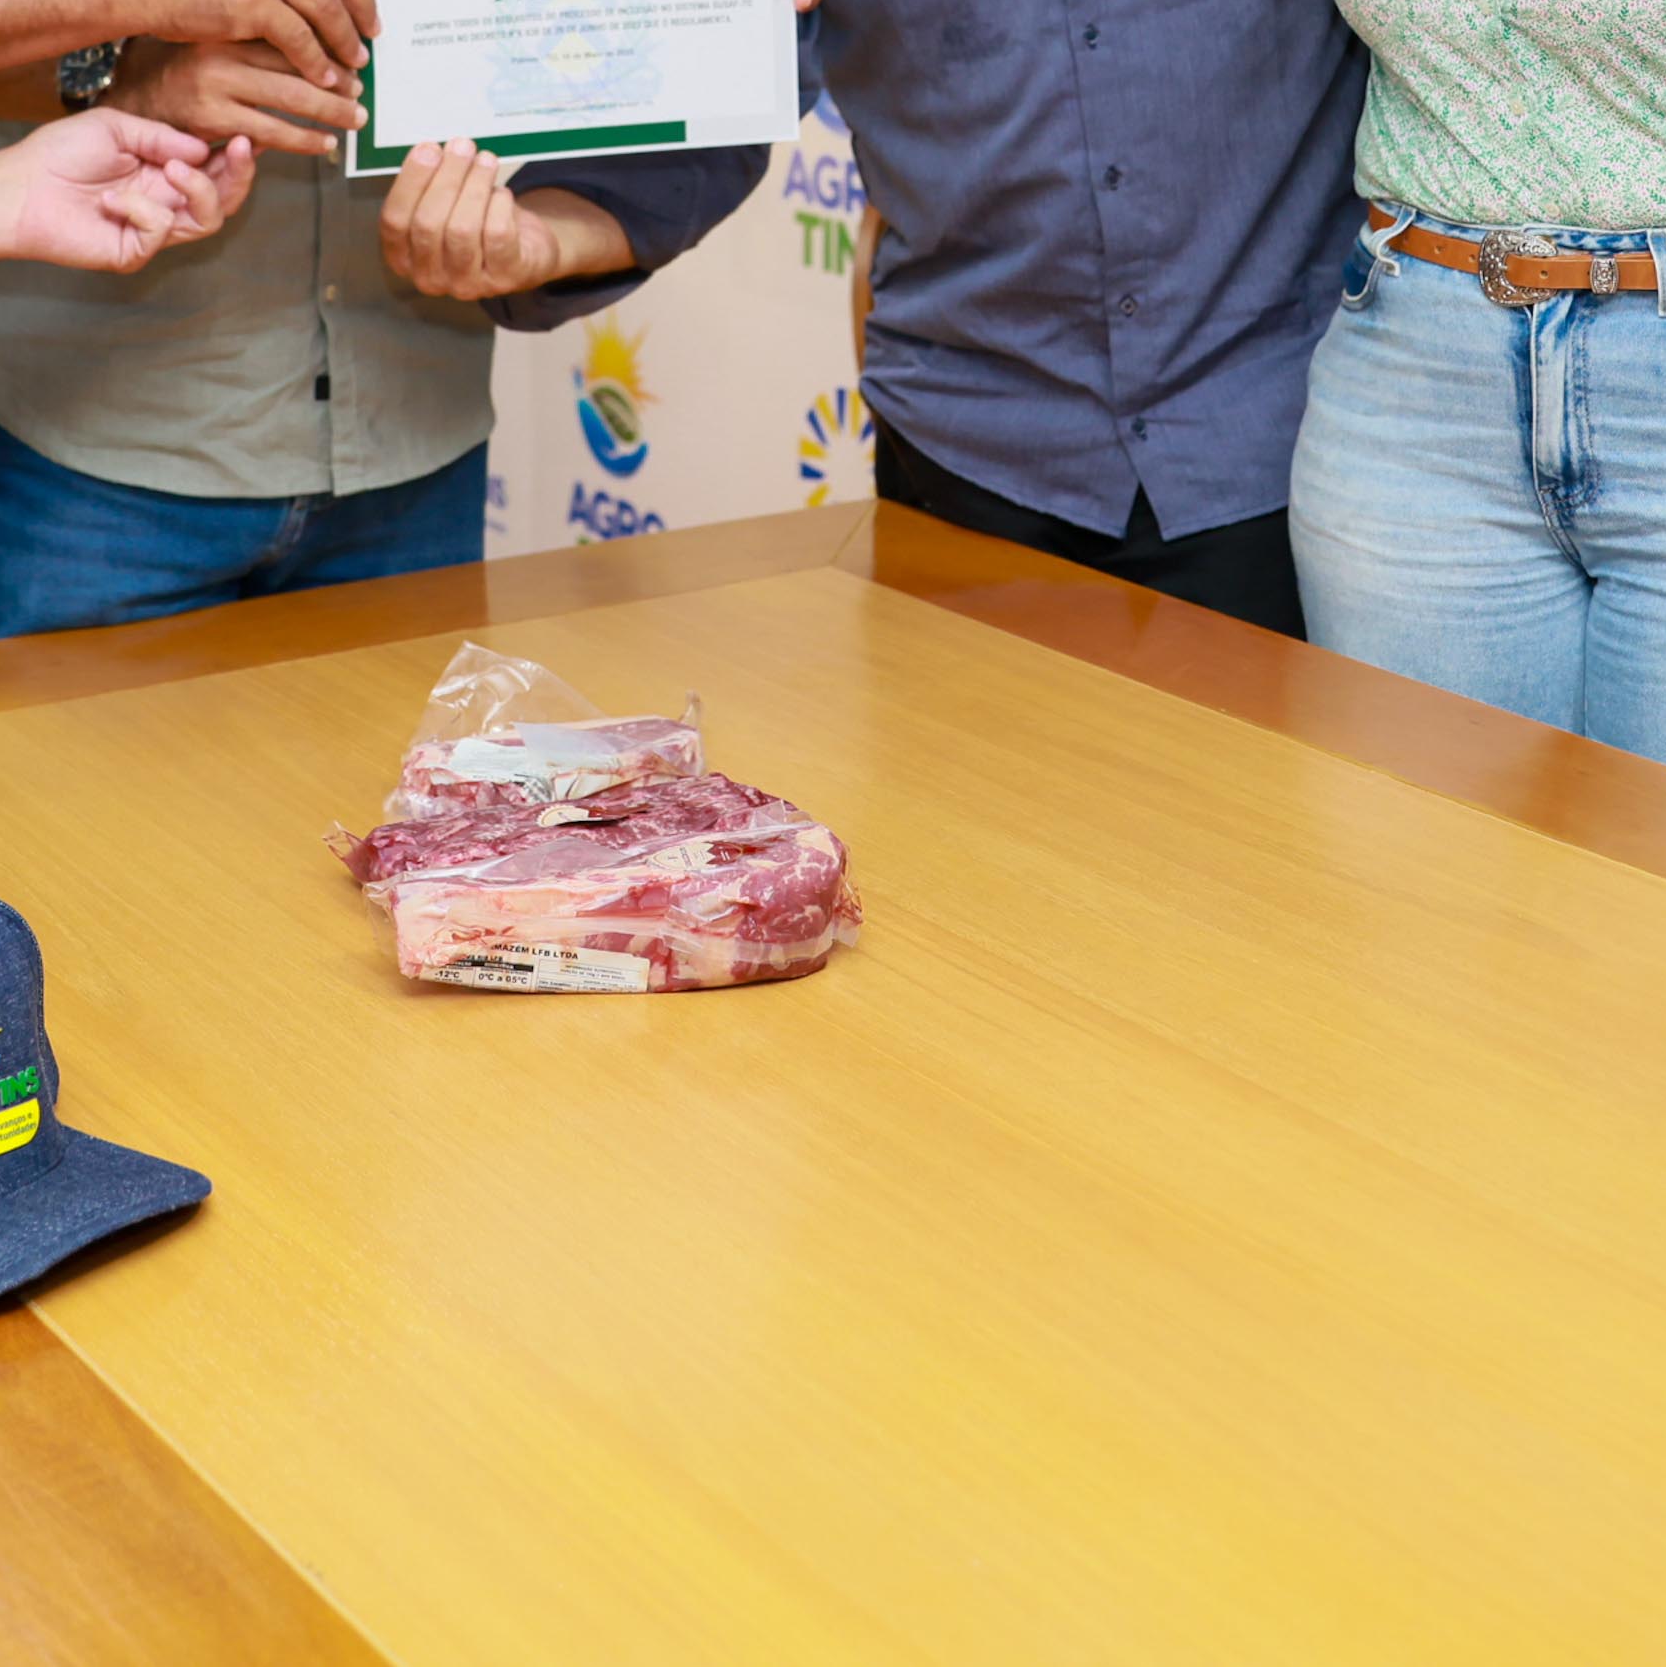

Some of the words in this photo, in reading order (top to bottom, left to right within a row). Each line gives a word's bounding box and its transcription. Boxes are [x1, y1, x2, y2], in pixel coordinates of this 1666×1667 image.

[795, 211, 856, 276] TIN
[490, 943, 530, 954] MAZÉM
[532, 948, 551, 957] LFB
[553, 950, 579, 960] LTDA
[478, 973, 495, 981] 0°C
[505, 975, 528, 985] 05°C
